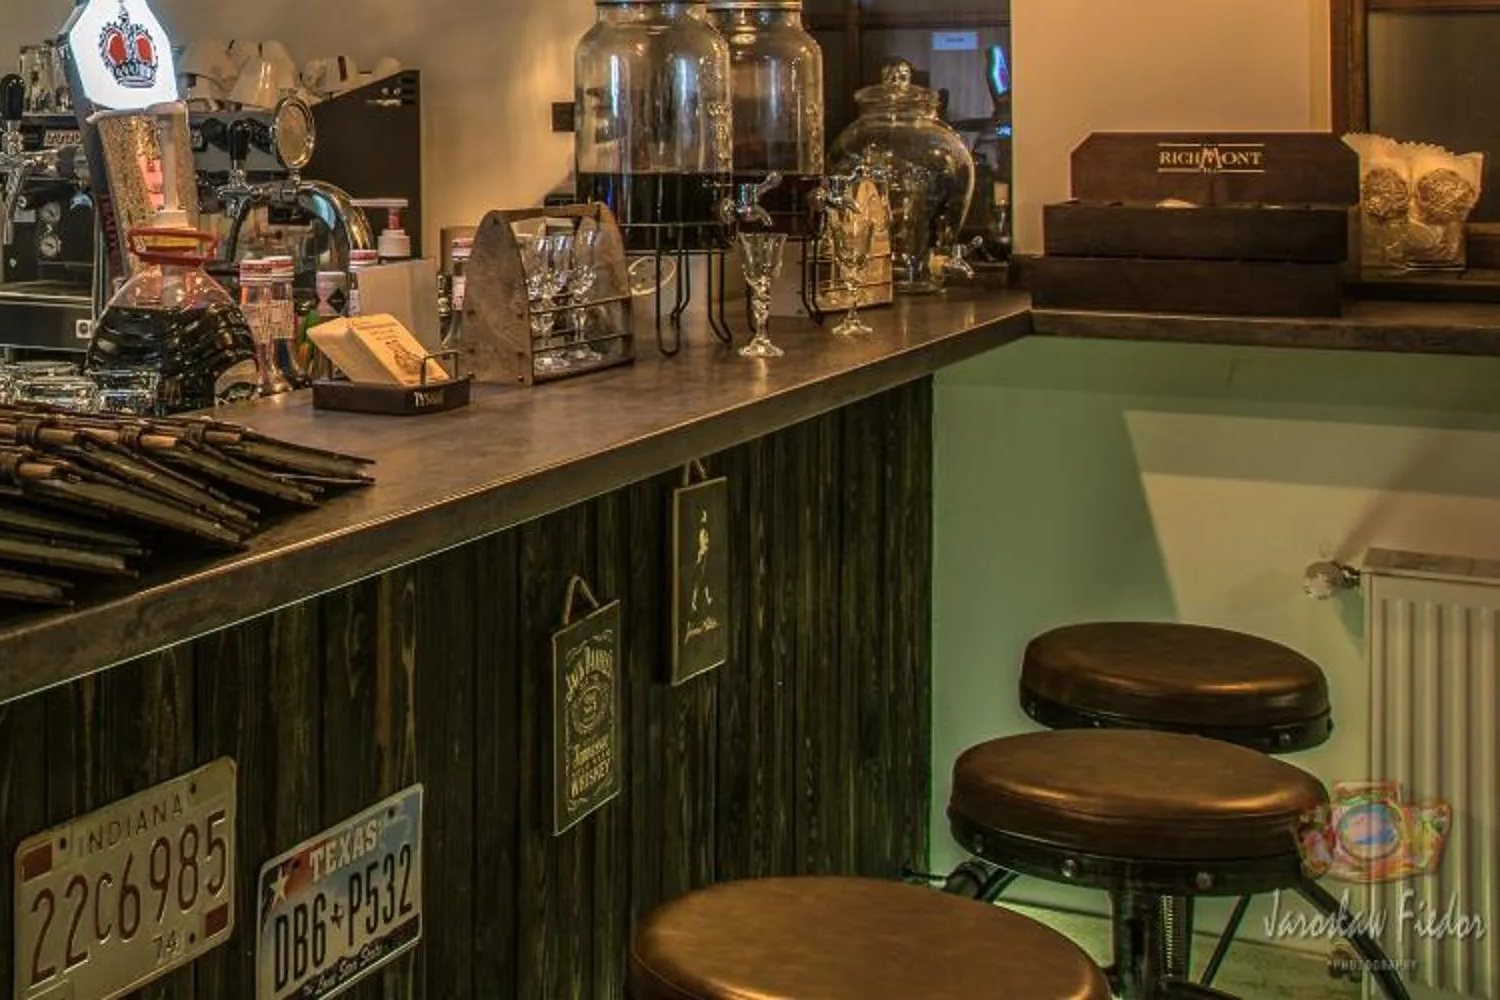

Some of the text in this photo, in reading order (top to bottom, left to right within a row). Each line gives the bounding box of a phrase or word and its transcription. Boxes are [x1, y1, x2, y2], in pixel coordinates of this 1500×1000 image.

[1159, 147, 1262, 168] RICHMONT
[78, 793, 183, 857] INDIANA
[309, 819, 381, 882] TEXAS
[30, 809, 227, 985] 22C6985
[274, 844, 412, 993] DB6 P532
[151, 930, 179, 962] 74
